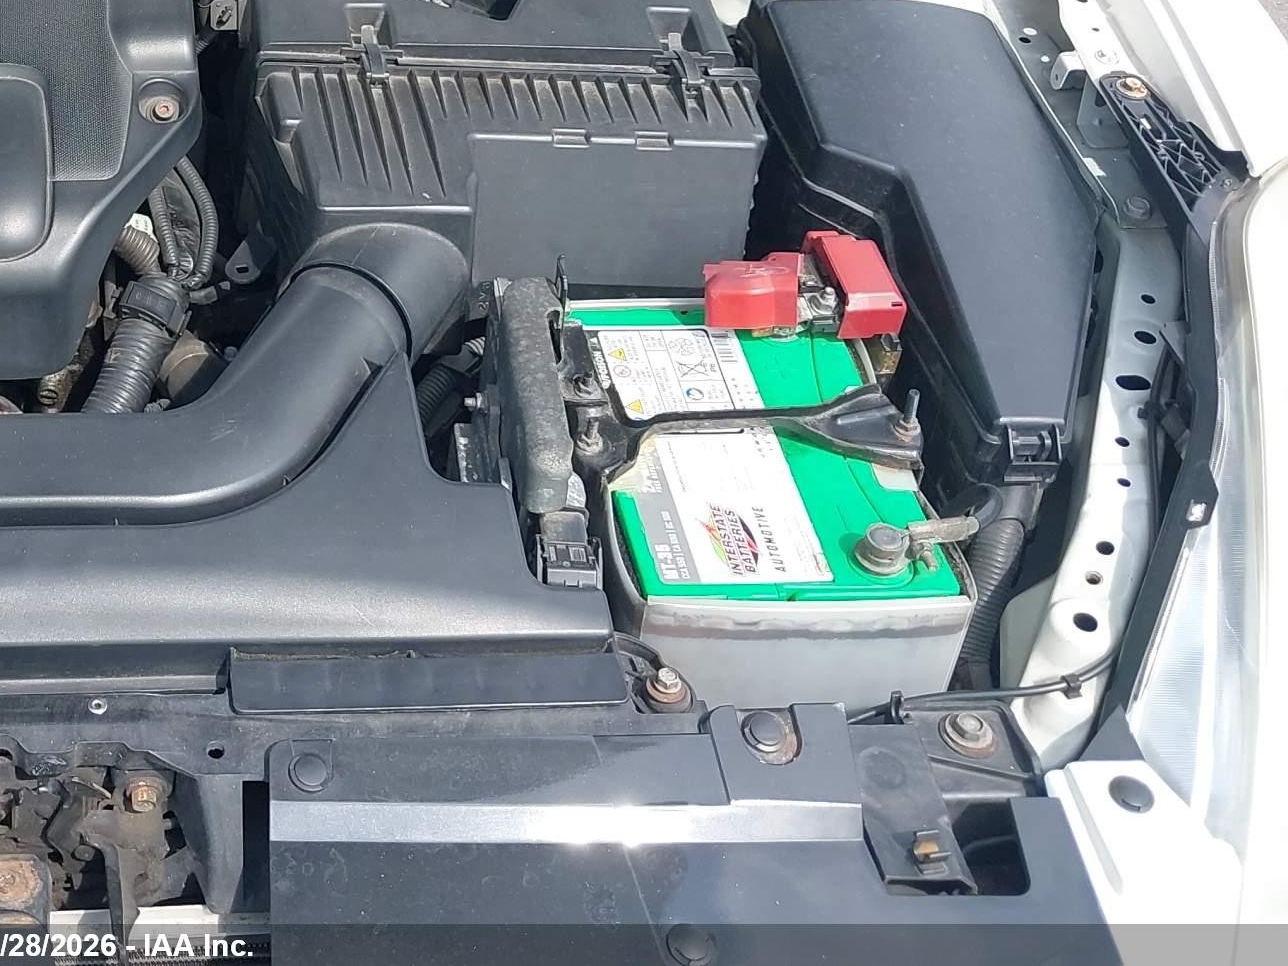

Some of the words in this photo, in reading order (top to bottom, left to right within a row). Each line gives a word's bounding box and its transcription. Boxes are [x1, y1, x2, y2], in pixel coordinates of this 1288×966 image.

[711, 505, 744, 575] INTERSTATE
[724, 509, 757, 573] BATTERIES
[751, 506, 787, 573] AUTOMOTIVE
